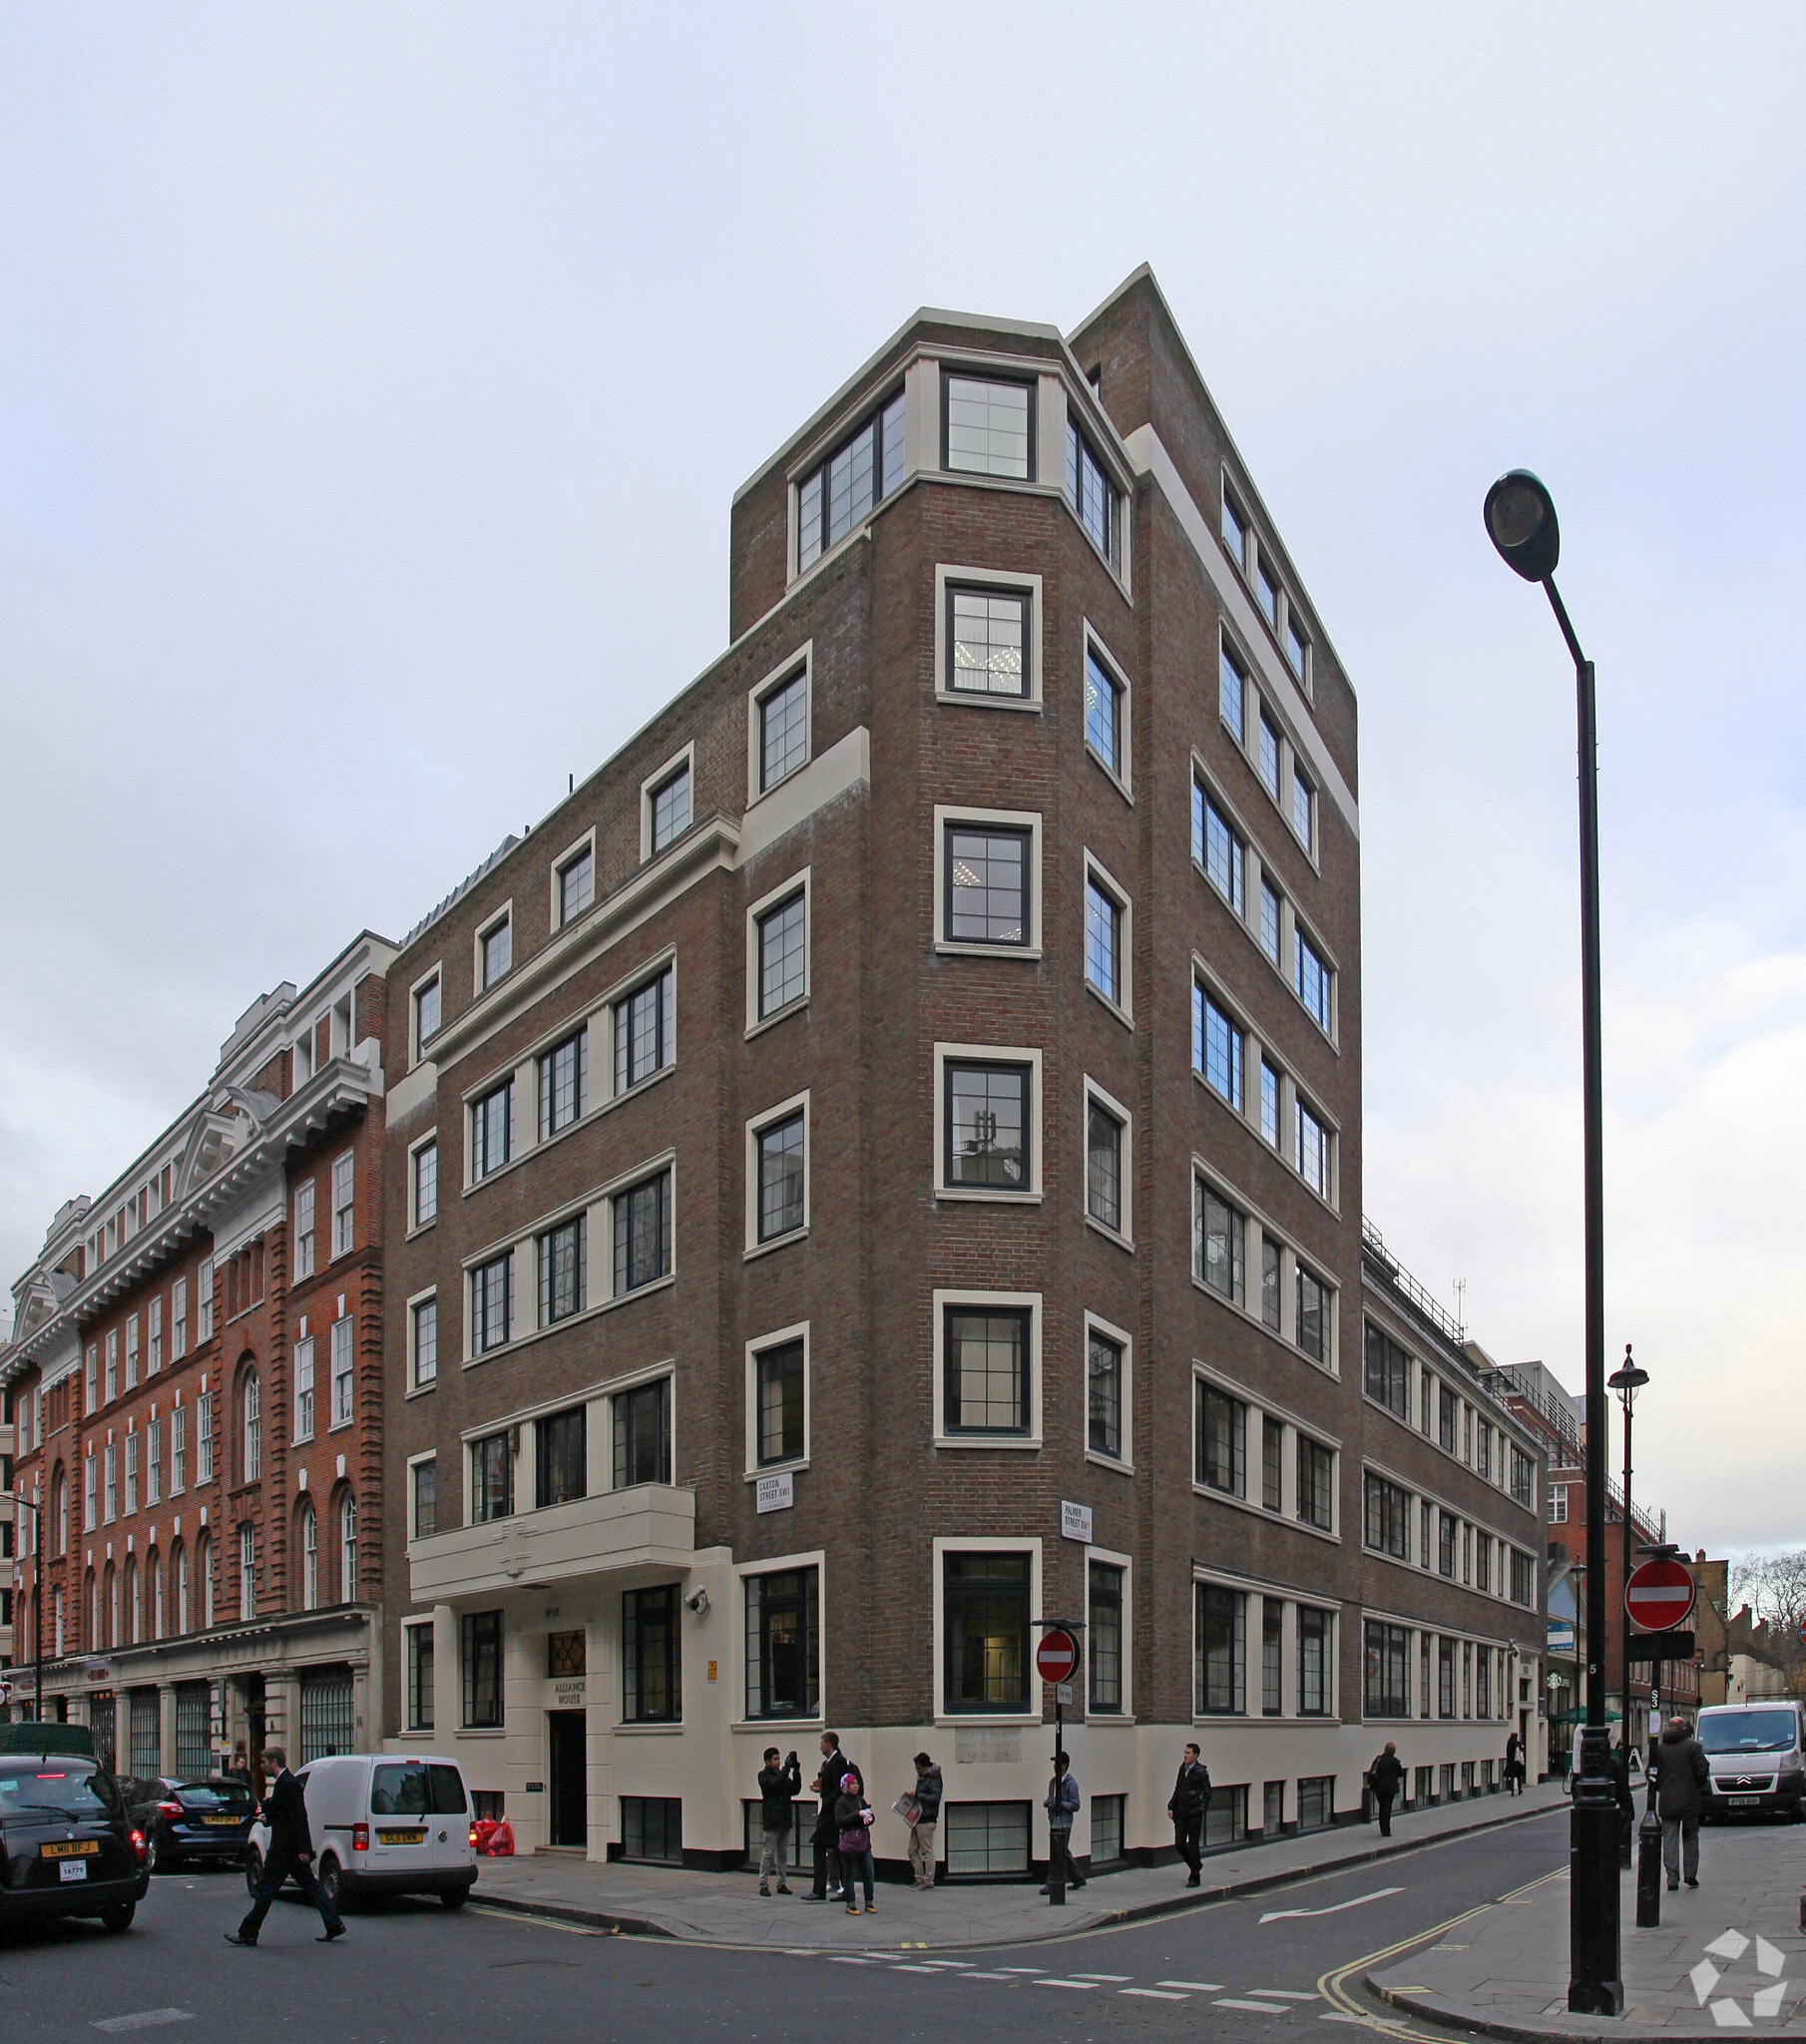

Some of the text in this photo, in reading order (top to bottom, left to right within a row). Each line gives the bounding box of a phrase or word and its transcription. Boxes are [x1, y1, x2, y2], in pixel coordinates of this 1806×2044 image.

[759, 1479, 779, 1491] CAXTON
[759, 1487, 790, 1501] STREET SW1
[1065, 1505, 1082, 1516] PALMER
[1065, 1516, 1090, 1531] STREET SW1
[1589, 1664, 1596, 1675] 5
[555, 1682, 586, 1694] ALLIANCE
[559, 1694, 581, 1705] HOUSE
[72, 1843, 91, 1852] BFJ
